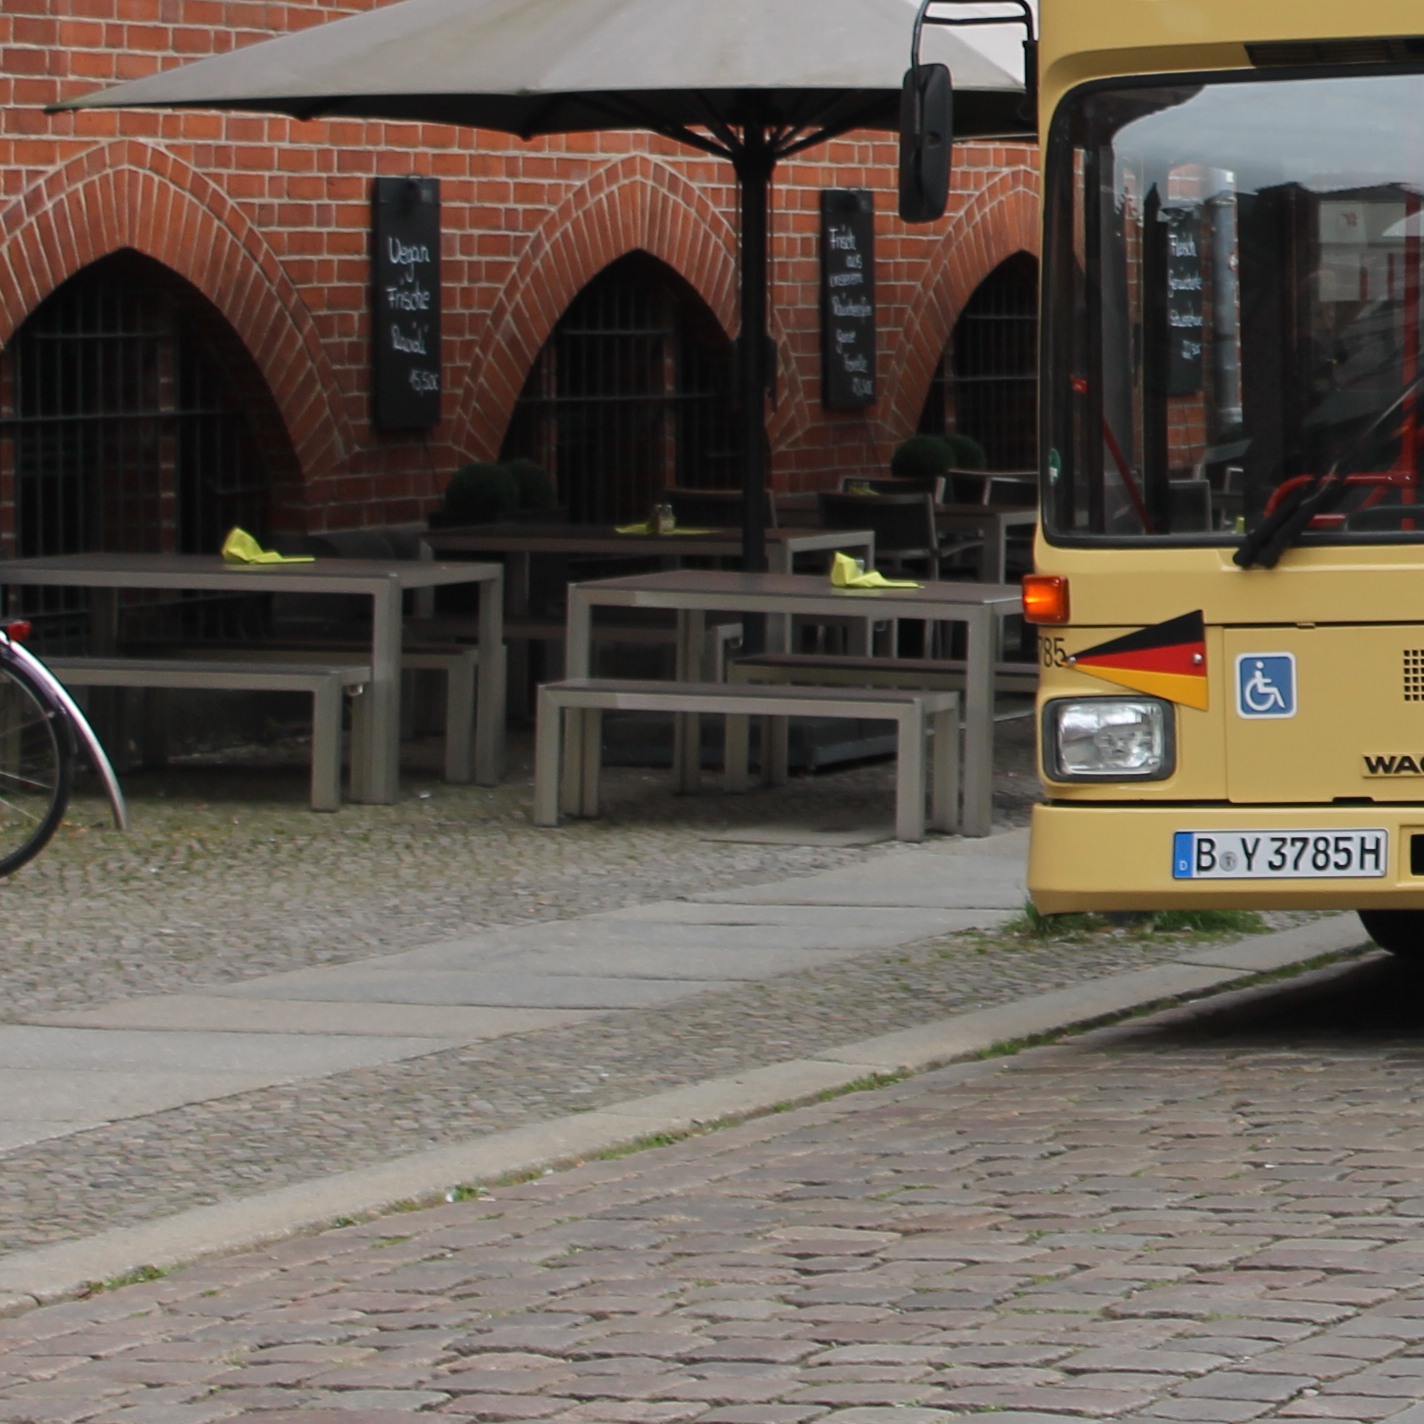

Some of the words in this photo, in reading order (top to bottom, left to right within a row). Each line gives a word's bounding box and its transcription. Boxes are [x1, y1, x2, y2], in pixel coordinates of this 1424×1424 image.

[388, 237, 430, 282] Vegan
[385, 278, 430, 310] Frische
[1196, 838, 1216, 872] B
[1241, 837, 1261, 872] Y
[1268, 836, 1381, 872] 3785H
